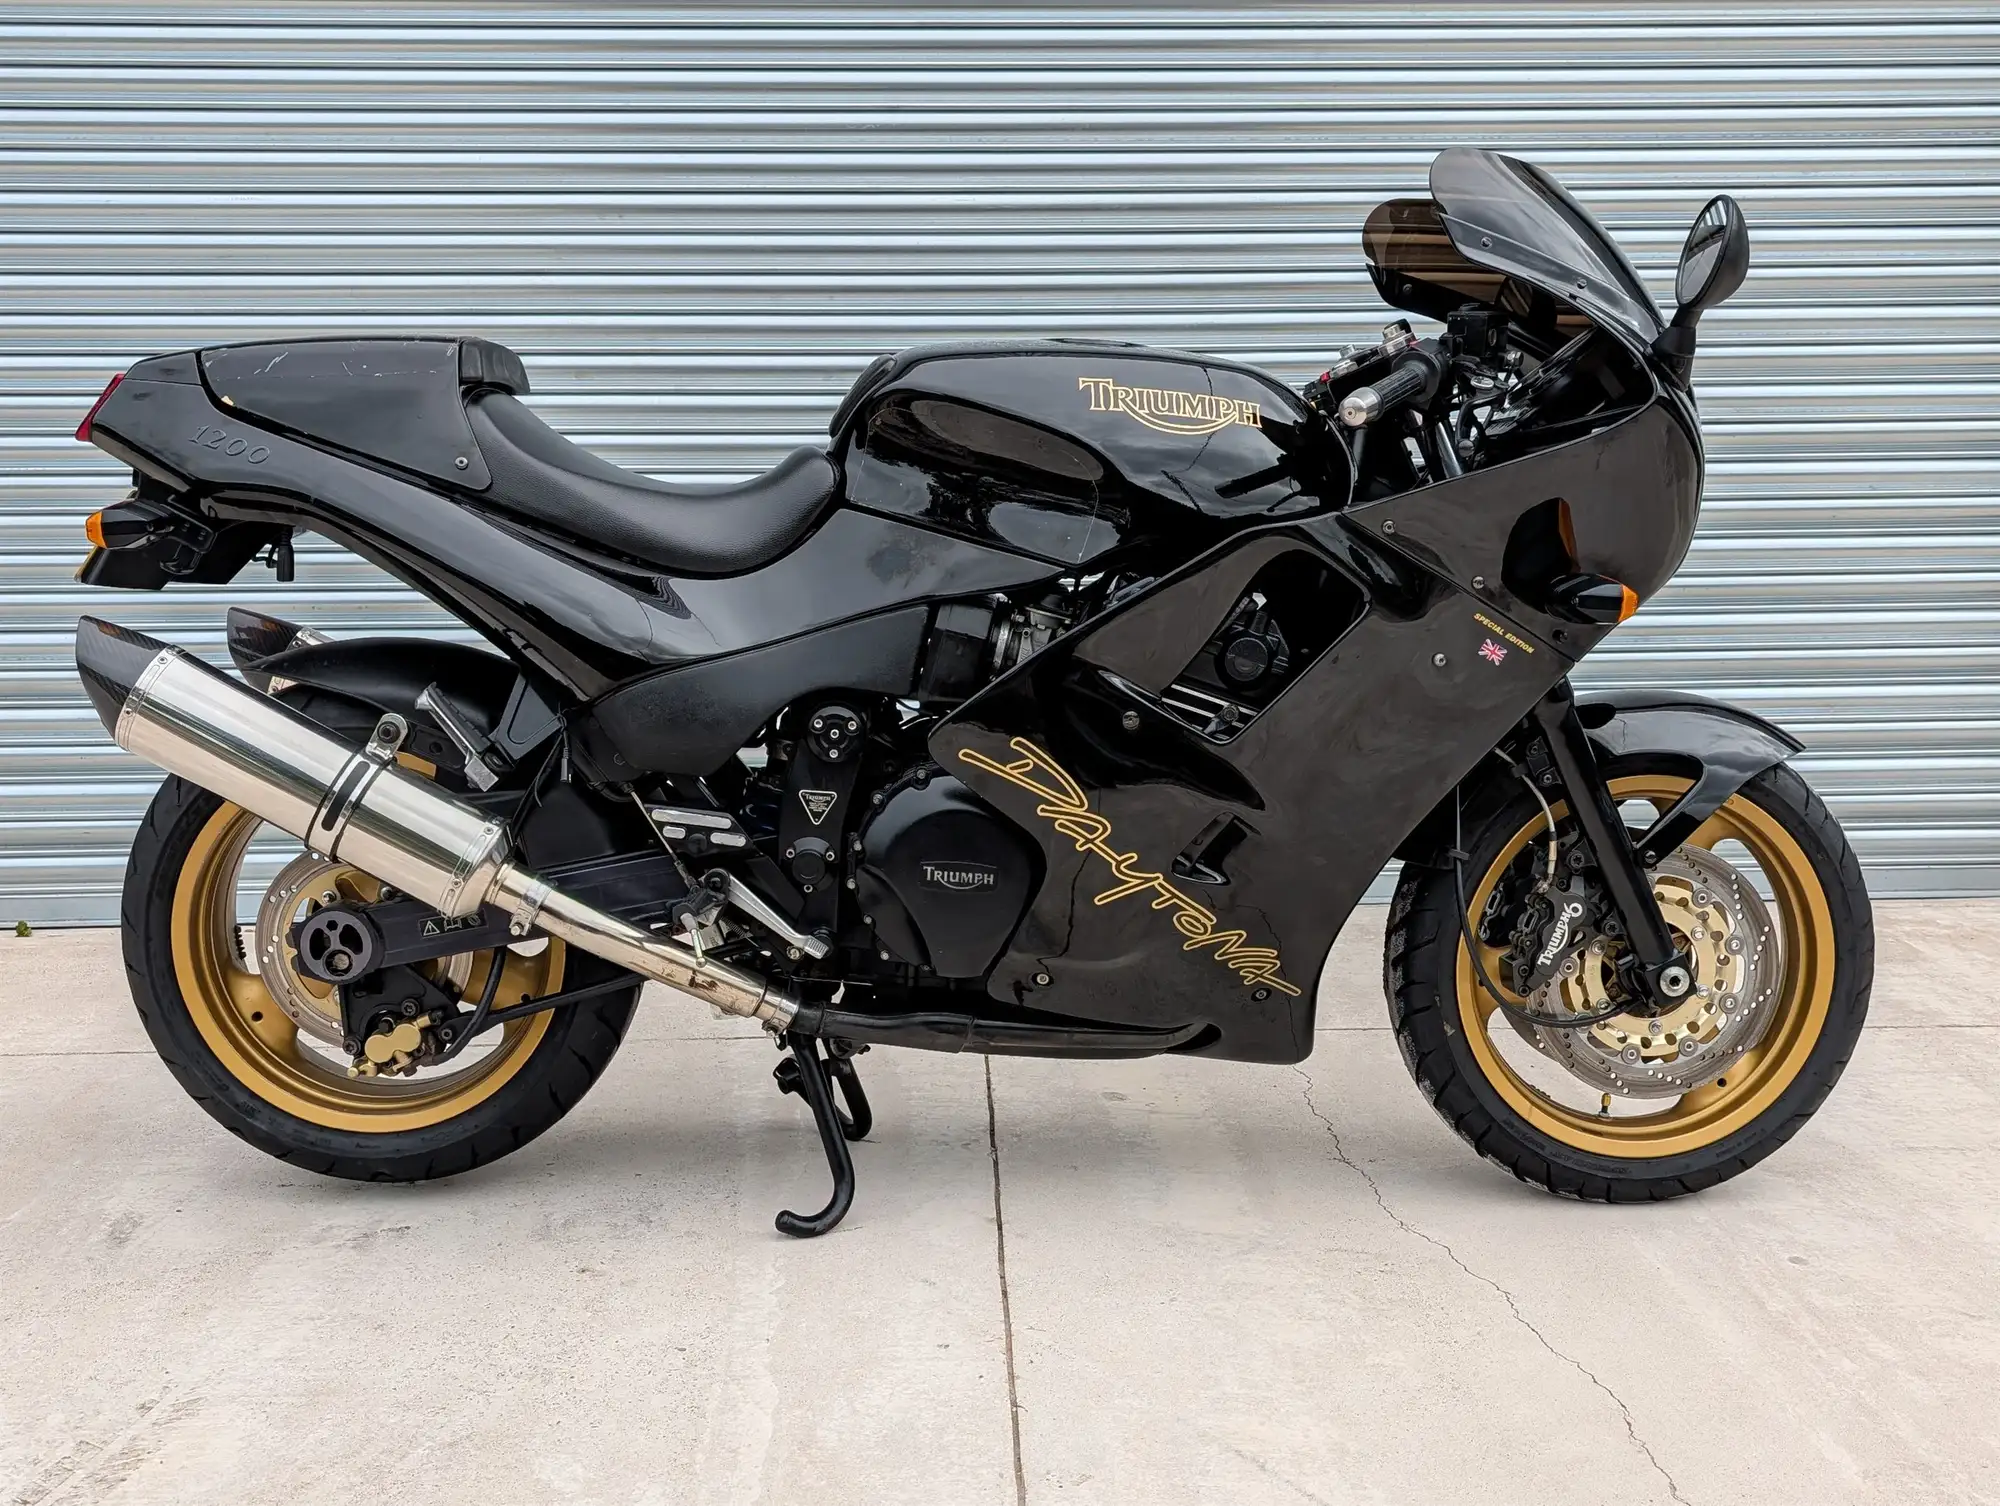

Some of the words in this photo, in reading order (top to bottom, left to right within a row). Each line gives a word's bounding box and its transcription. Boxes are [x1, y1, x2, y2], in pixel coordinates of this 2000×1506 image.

[1078, 377, 1262, 435] TRIUMPH
[188, 425, 271, 465] 1200
[1473, 612, 1505, 636] SPECIAL
[1504, 632, 1535, 654] EDITION
[923, 866, 995, 890] TRIUMPH
[1537, 911, 1572, 966] TRIUMPH
